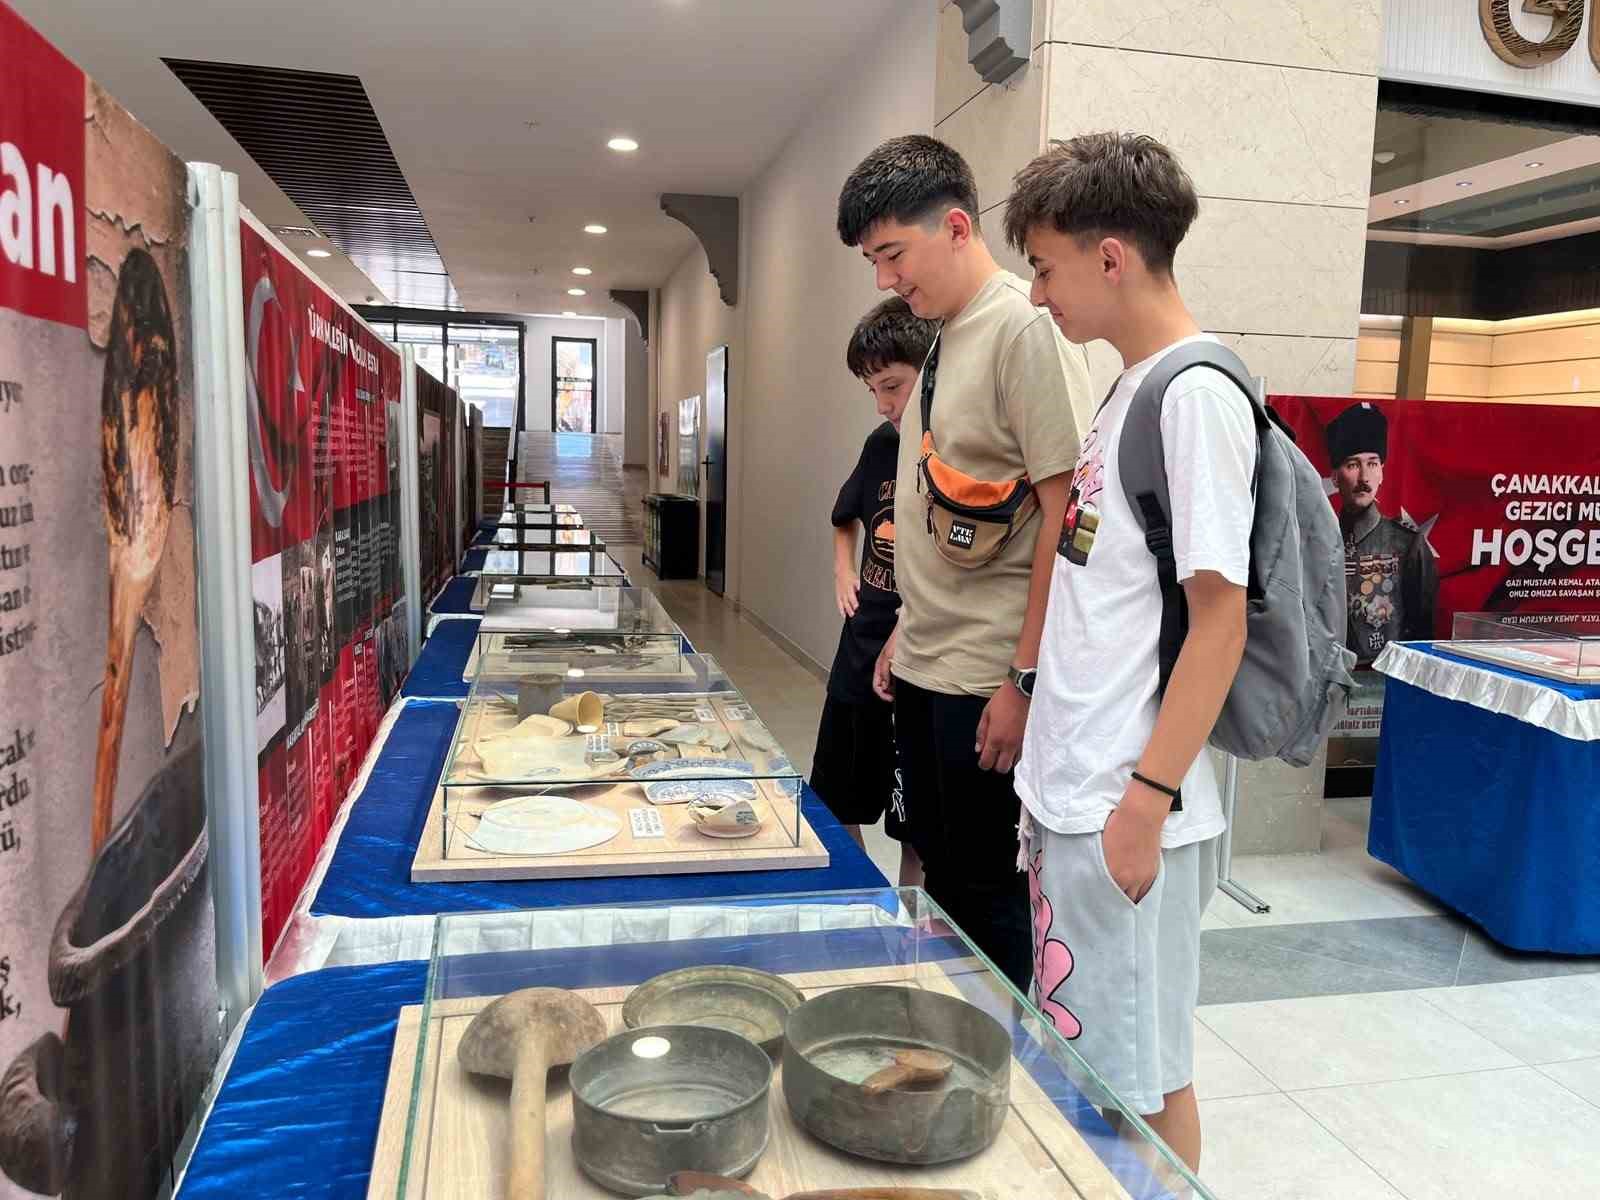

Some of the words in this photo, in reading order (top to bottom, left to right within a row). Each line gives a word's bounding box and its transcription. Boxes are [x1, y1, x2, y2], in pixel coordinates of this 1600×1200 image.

[0, 141, 77, 284] an
[1491, 473, 1600, 497] ÇANAKKAL
[1505, 500, 1573, 521] GEZİCİ
[1471, 528, 1600, 573] HOŞGE
[1523, 578, 1556, 587] MUSTAFA
[1558, 578, 1583, 587] KEMAL
